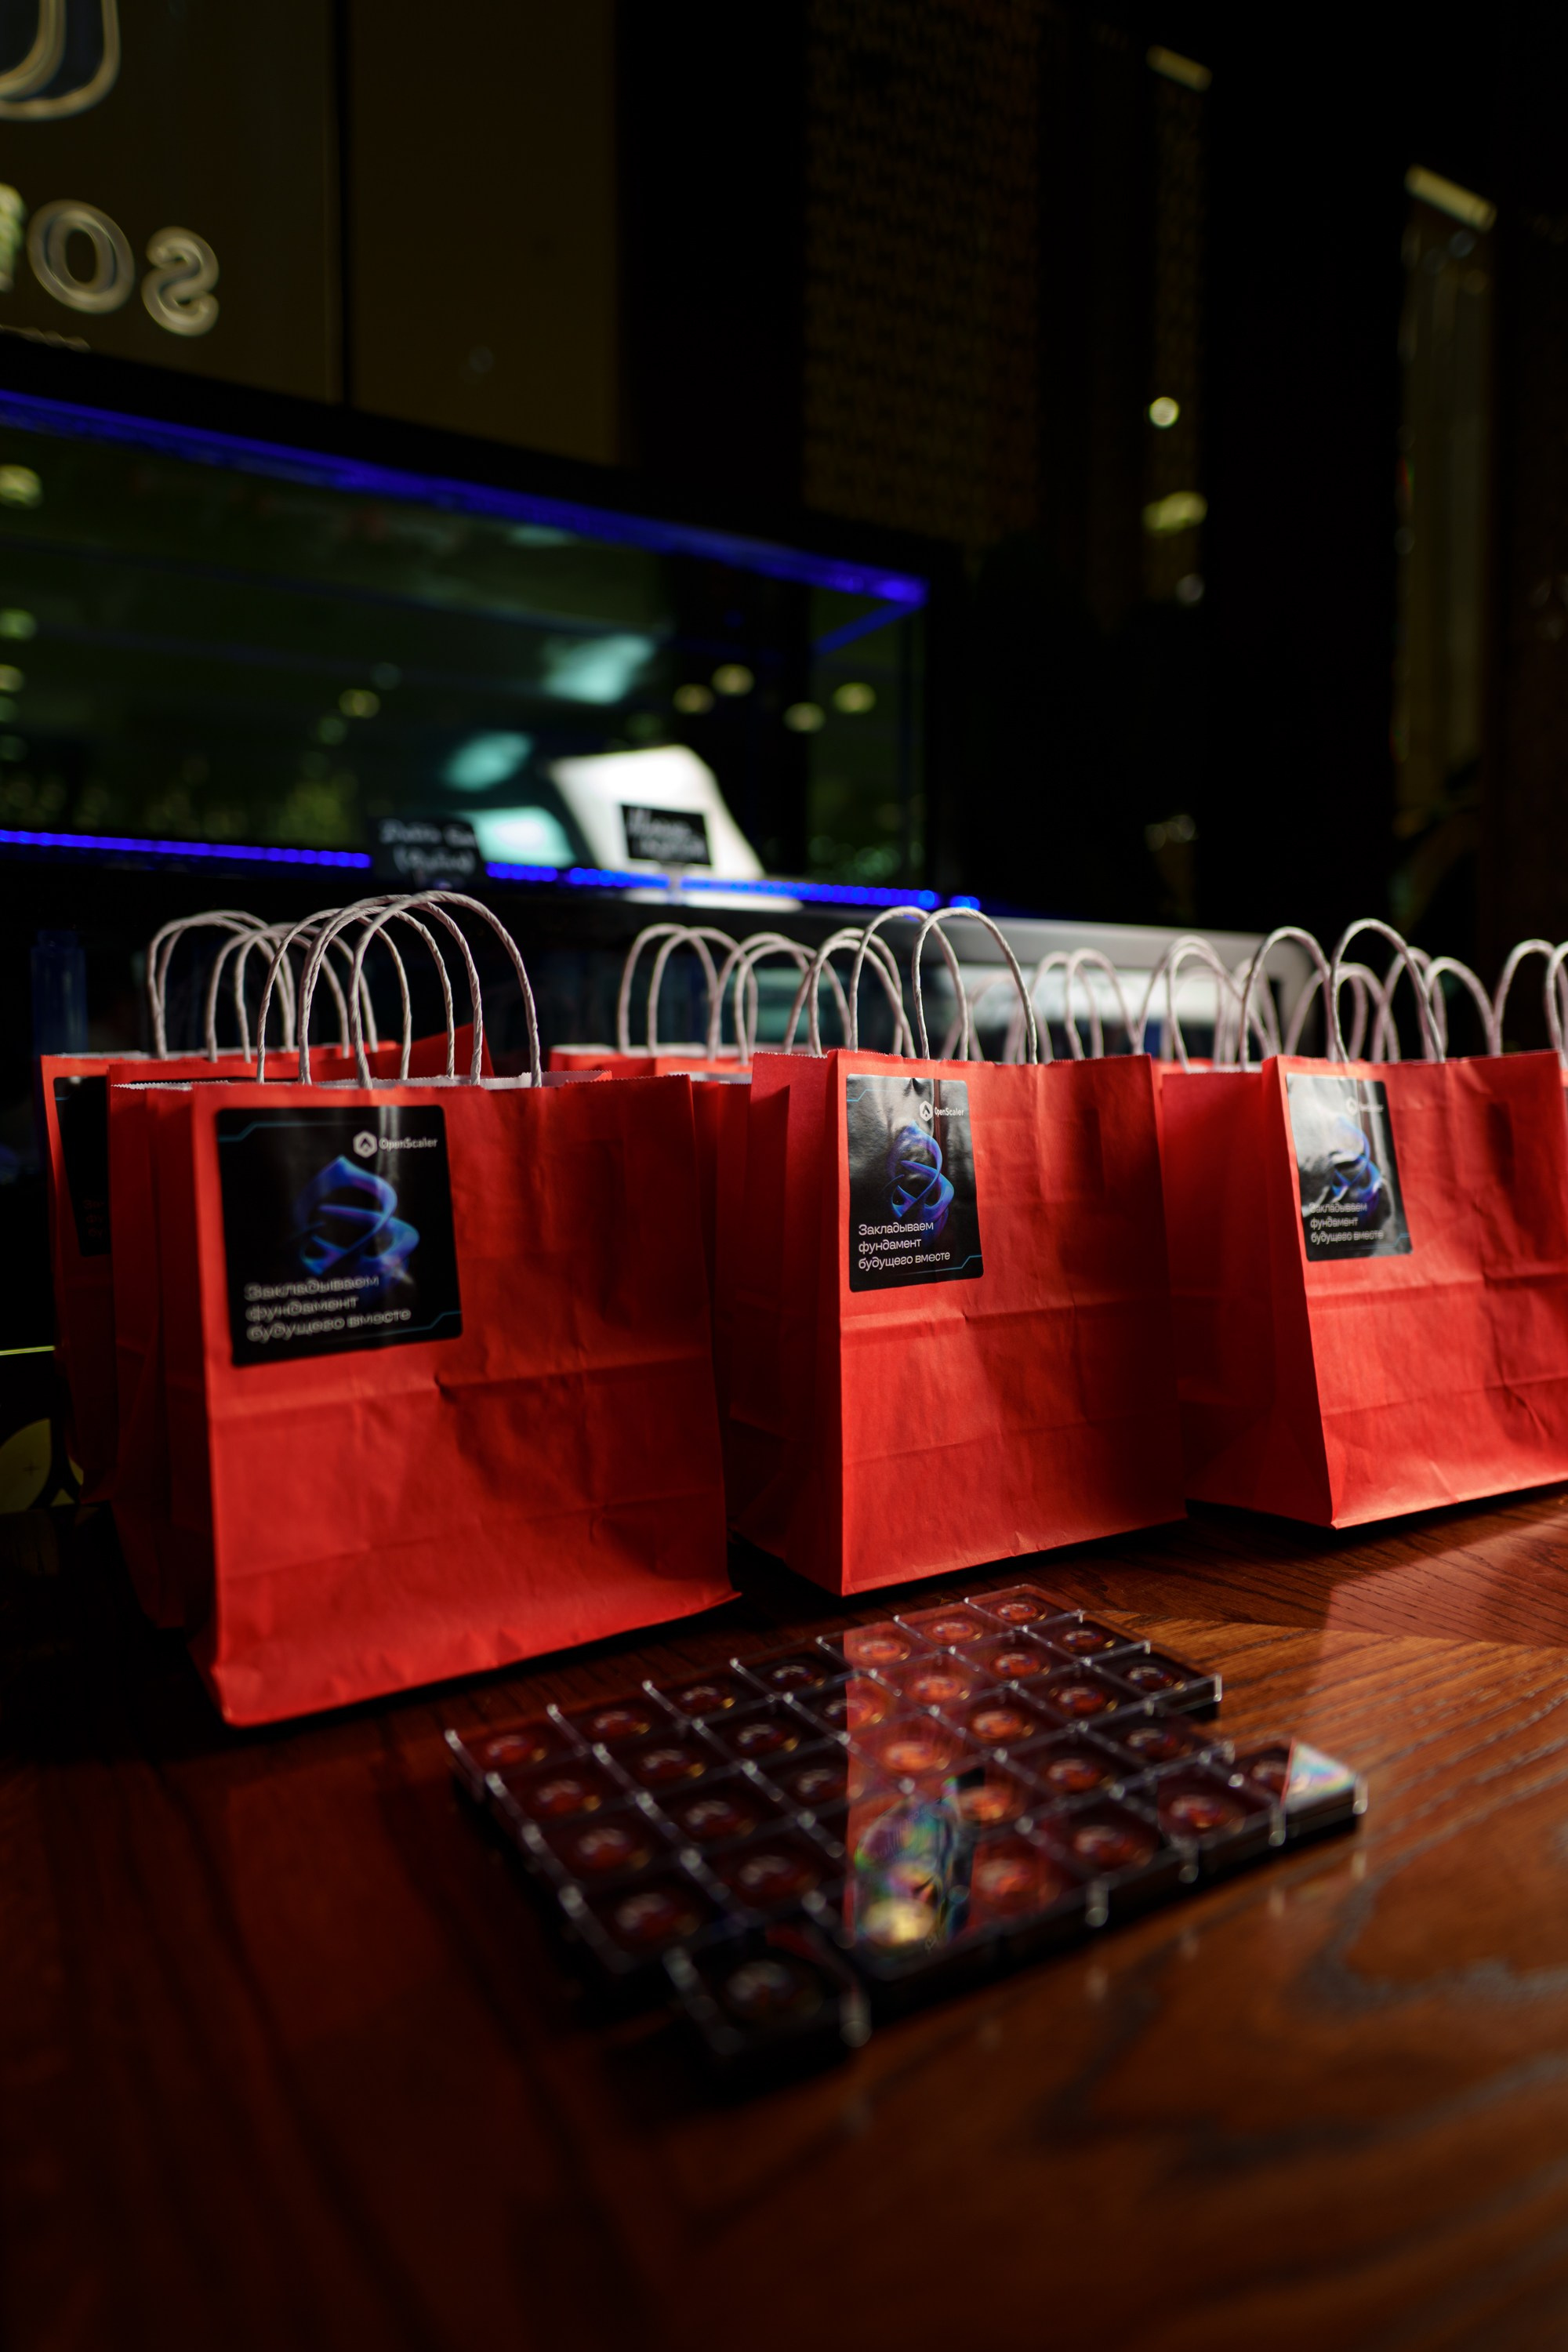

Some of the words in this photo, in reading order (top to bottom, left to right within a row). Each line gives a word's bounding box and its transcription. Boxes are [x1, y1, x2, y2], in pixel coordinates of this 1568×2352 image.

[934, 1105, 964, 1118] OpenScaler
[379, 1137, 437, 1151] OpenScaler
[1309, 1202, 1367, 1214] Закладываем
[858, 1221, 934, 1236] Закладываем
[1310, 1216, 1358, 1229] фундамент
[1311, 1230, 1352, 1245] будущего
[1353, 1229, 1385, 1240] вместе
[858, 1238, 921, 1254] фундамент
[858, 1252, 913, 1271] будущего
[915, 1250, 950, 1264] вместе
[244, 1275, 379, 1301] Закладываем
[245, 1296, 359, 1323] фундамент
[246, 1317, 346, 1344] будущего
[347, 1308, 412, 1329] вместе
